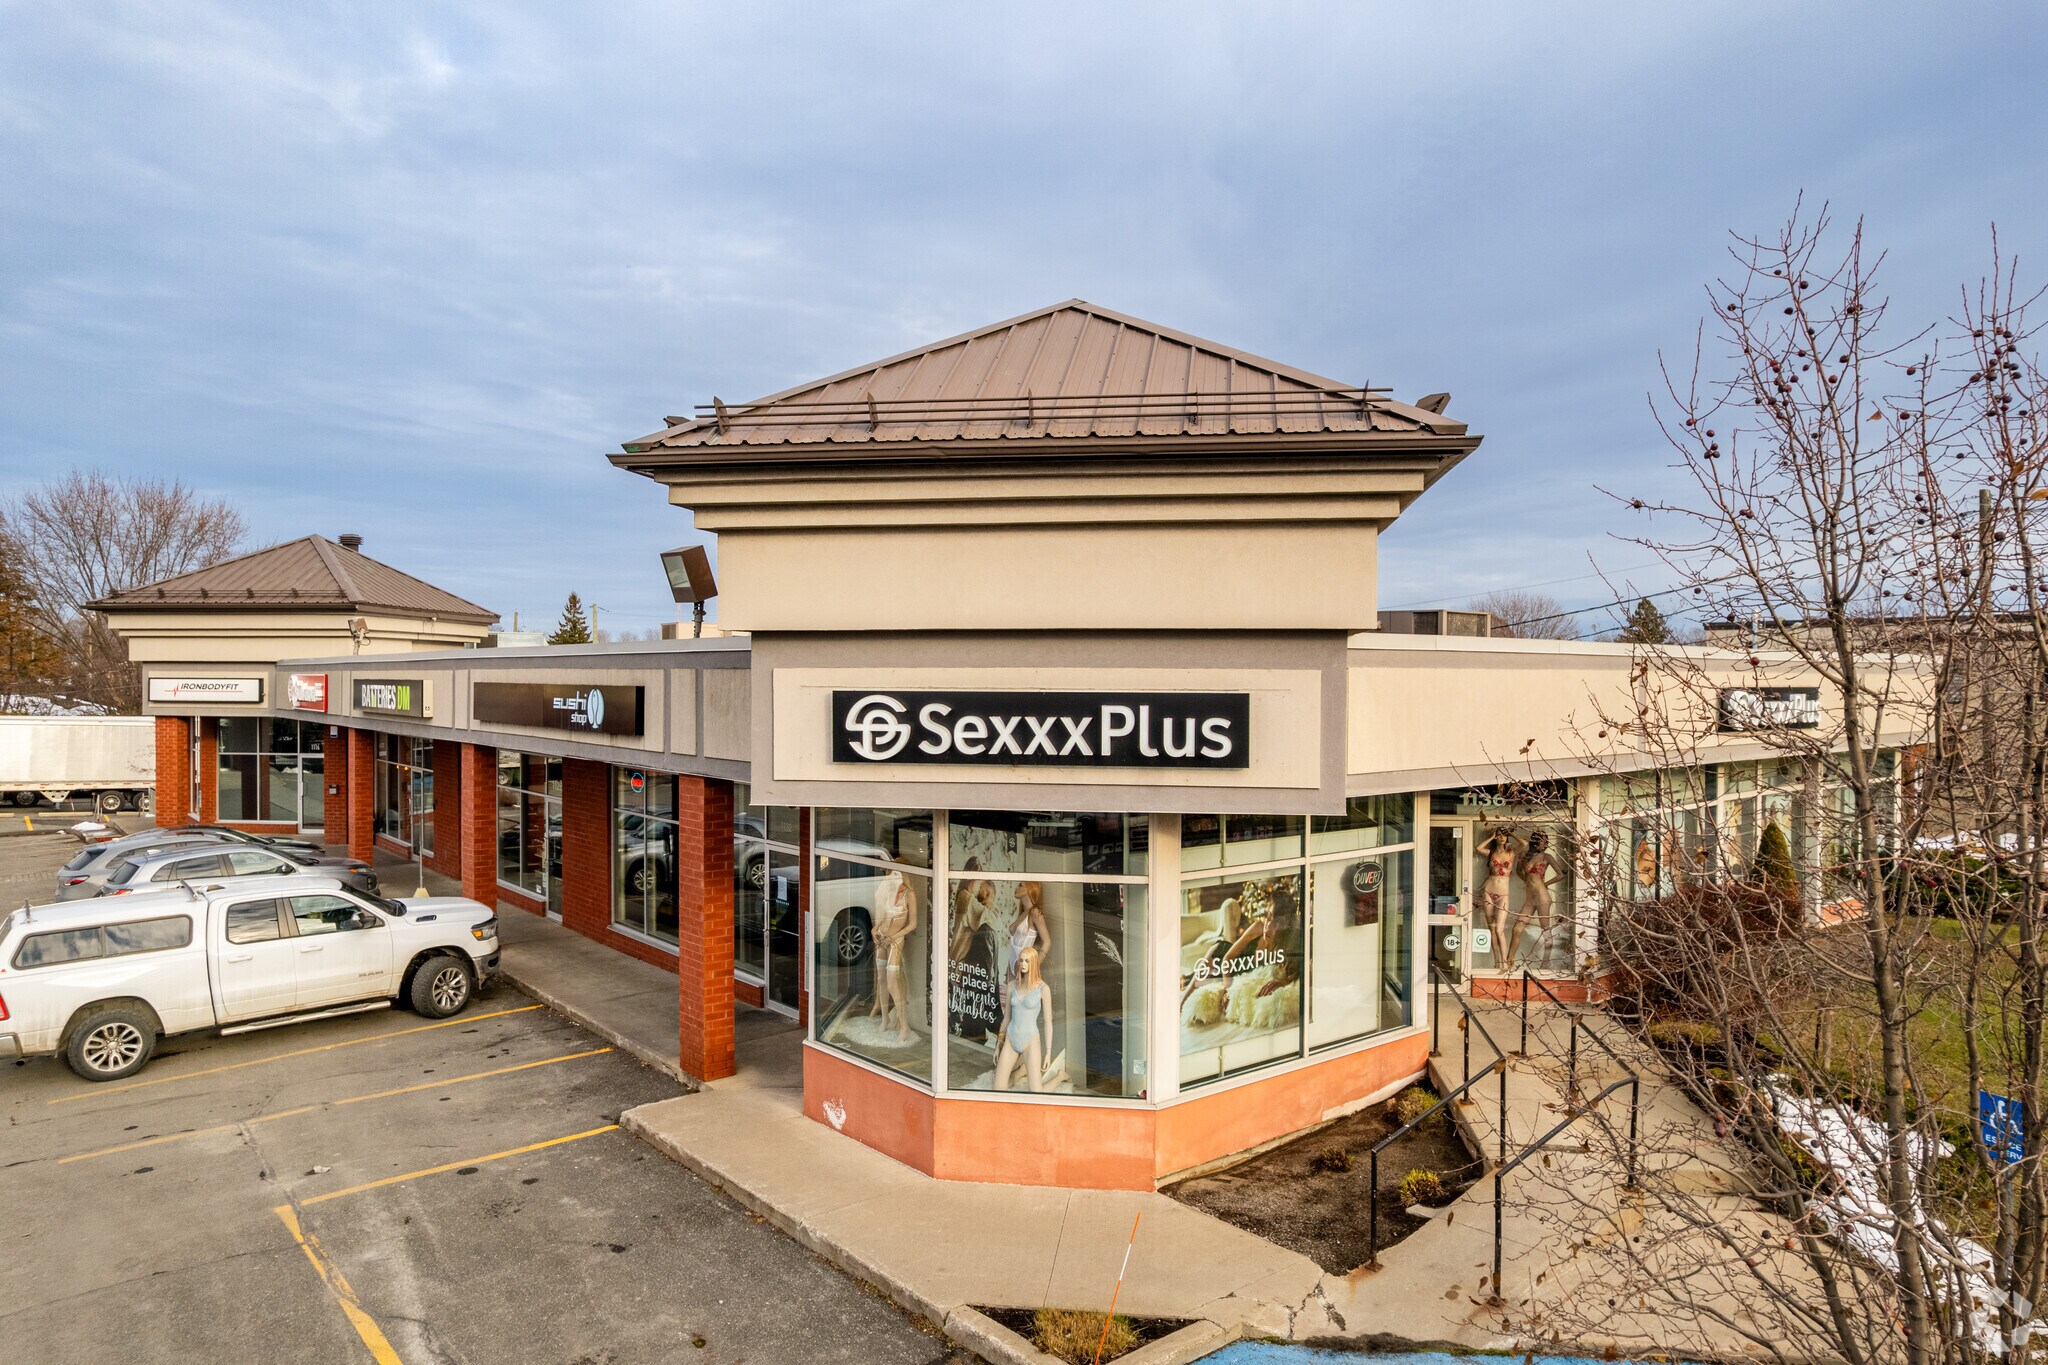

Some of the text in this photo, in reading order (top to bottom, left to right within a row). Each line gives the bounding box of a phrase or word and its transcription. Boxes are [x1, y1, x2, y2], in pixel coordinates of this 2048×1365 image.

[361, 684, 411, 711] BATTERIES DM
[553, 690, 587, 711] sushi
[570, 712, 587, 725] shop
[918, 702, 1233, 759] SexxxPlus
[1459, 792, 1506, 807] 1136
[1355, 870, 1382, 886] OUVERT
[958, 963, 989, 980] année,
[1211, 948, 1285, 976] SexxxPlus
[962, 973, 988, 991] place
[989, 980, 996, 993] à
